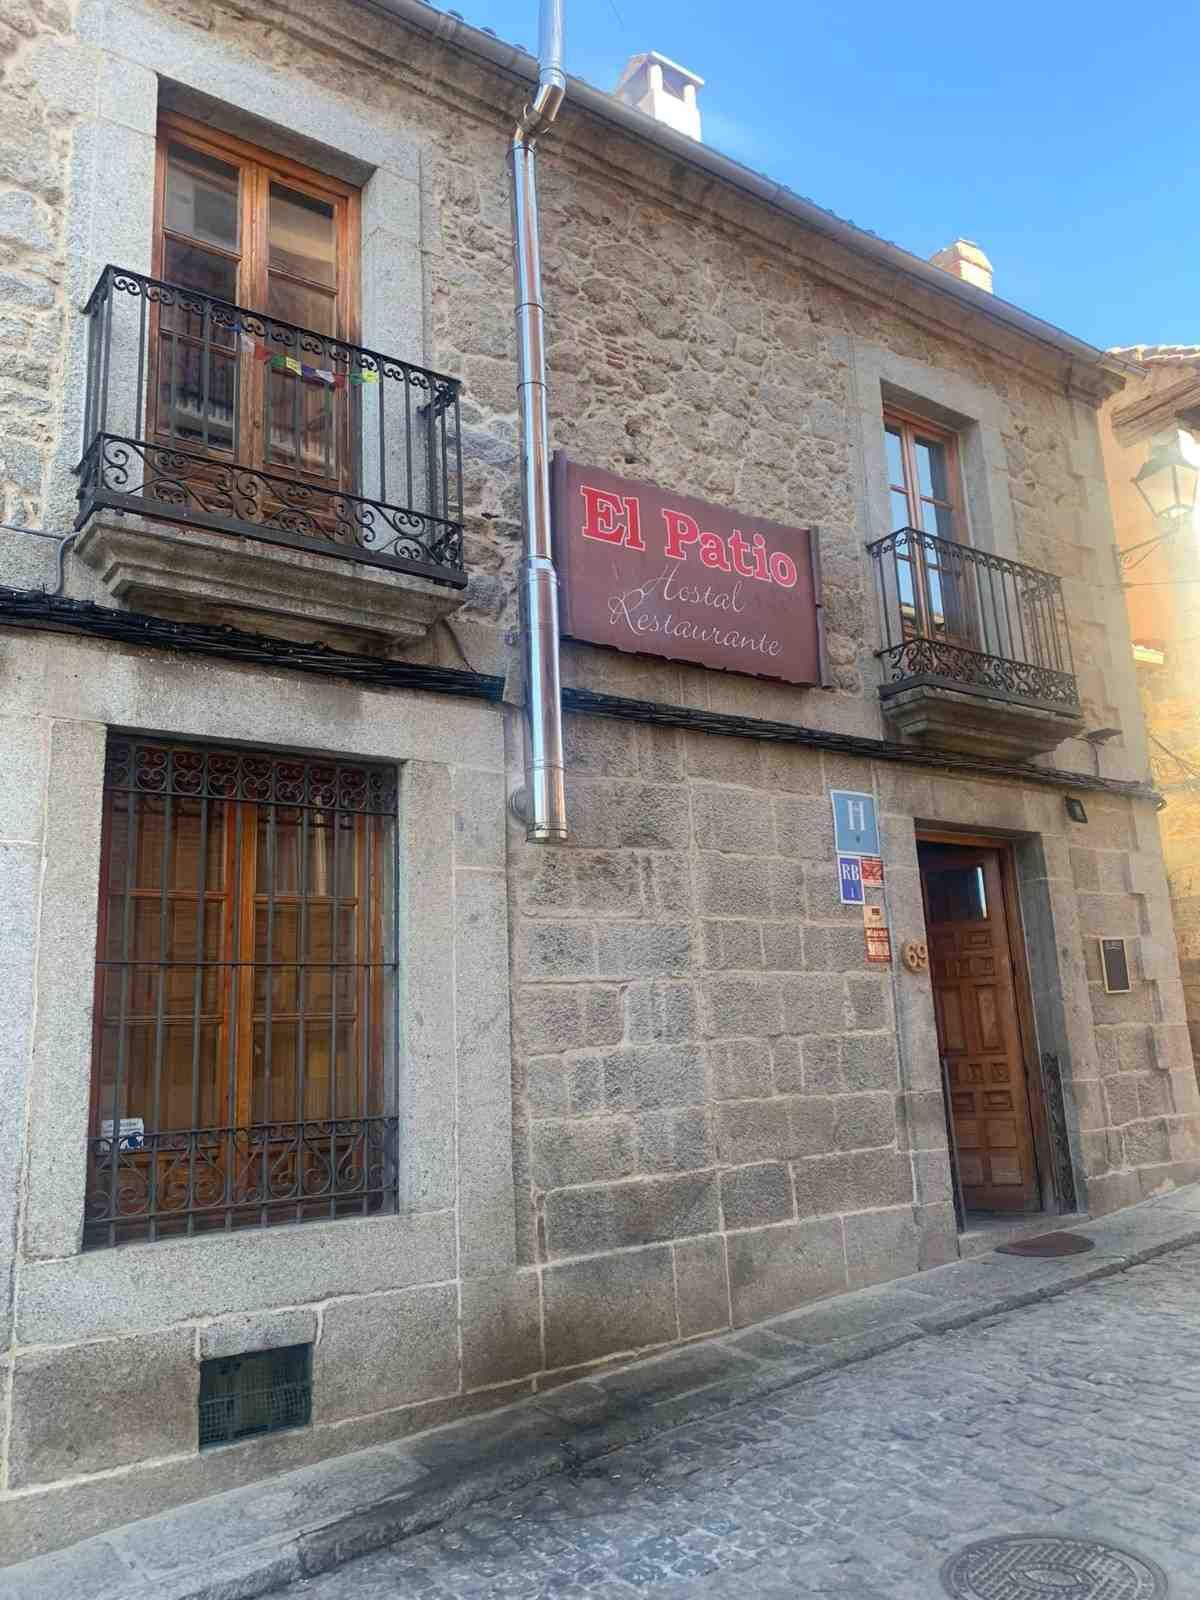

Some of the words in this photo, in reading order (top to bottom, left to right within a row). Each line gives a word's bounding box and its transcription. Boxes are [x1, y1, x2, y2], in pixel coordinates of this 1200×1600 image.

[580, 485, 645, 551] El
[662, 508, 797, 588] Patio
[641, 561, 745, 613] Hostal
[608, 588, 782, 657] Restaurante
[842, 864, 860, 880] RB
[908, 943, 928, 968] 69
